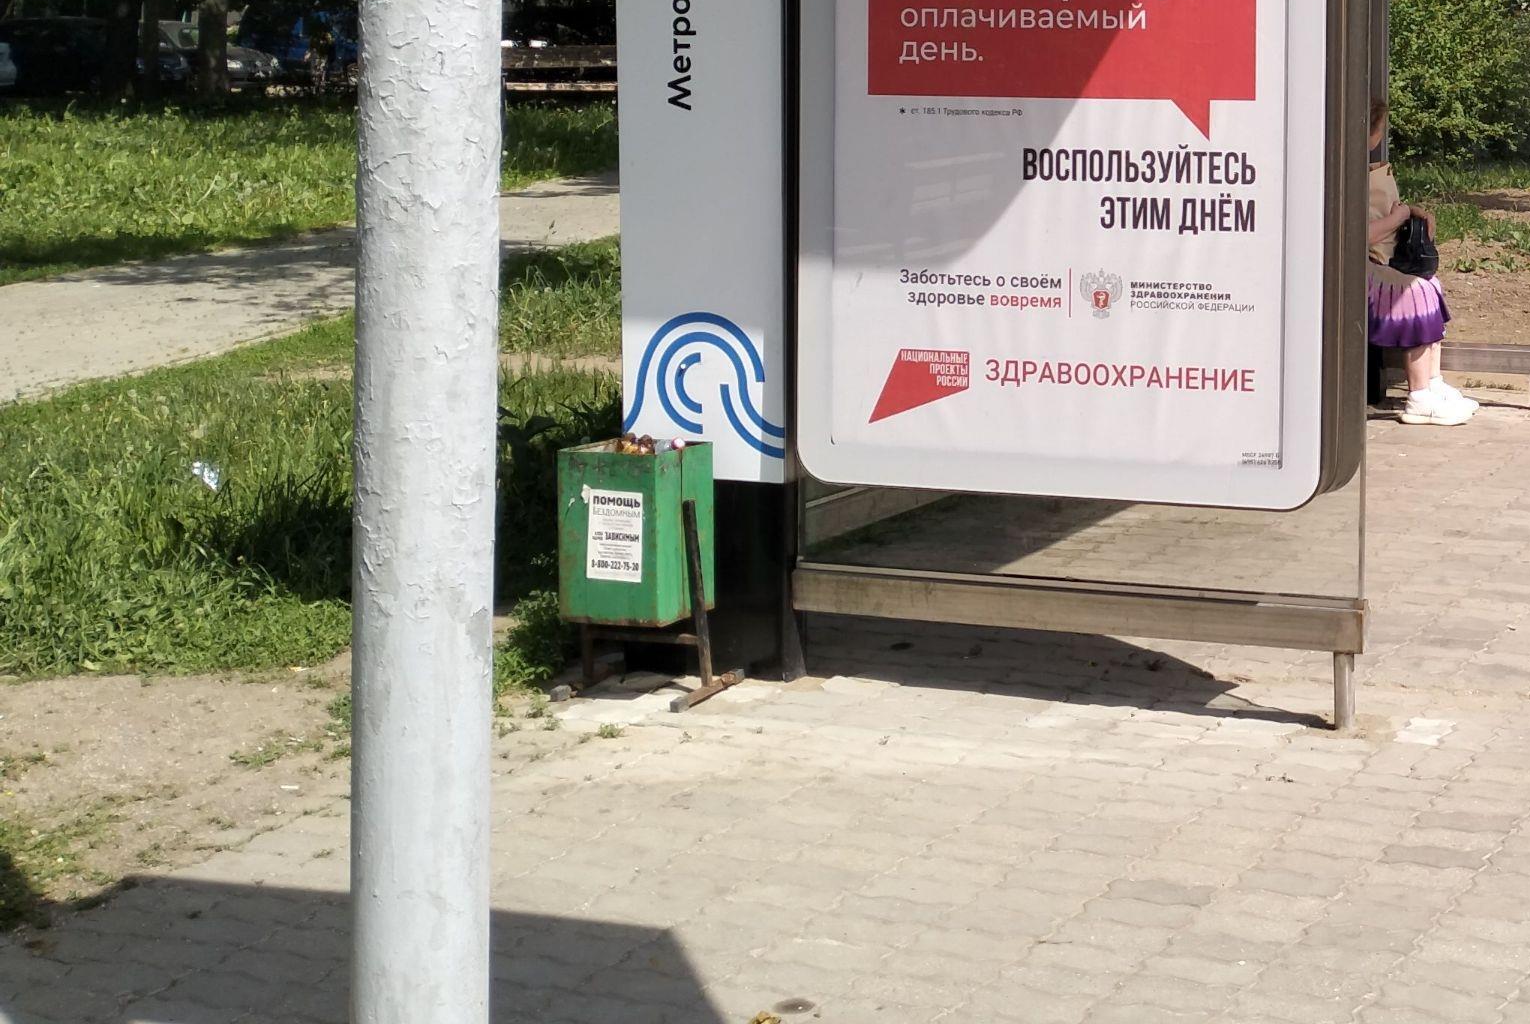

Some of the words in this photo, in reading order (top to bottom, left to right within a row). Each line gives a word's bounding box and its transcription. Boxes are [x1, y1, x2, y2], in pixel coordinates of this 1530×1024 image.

[900, 3, 1147, 29] оплачиваемый
[899, 40, 984, 64] день.
[1011, 108, 1023, 117] РФ
[1022, 145, 1257, 185] ВОСПОЛЬЗУЙТЕСЬ
[1099, 196, 1171, 232] ЭТИМ
[1178, 193, 1256, 236] ДНЁМ
[900, 268, 991, 288] Заботьтесь
[996, 277, 1006, 288] о
[1010, 273, 1063, 290] своём
[1130, 281, 1213, 292] МИНИСТЕРСТВО
[907, 289, 985, 307] здоровье
[990, 293, 1062, 309] вовремя
[1130, 290, 1232, 301] ЗДРАВООХРАНЕНИЯ
[1130, 300, 1195, 310] РОССИЙСКОЙ
[1197, 302, 1256, 313] ФЕДЕРАЦИИ
[900, 350, 969, 365] НАЦИОНАЛЬНЫЕ
[929, 363, 969, 376] ПРОЕКТЫ
[985, 359, 1256, 392] ЗДРАВООХРАНЕНИЕ
[936, 374, 969, 388] РОССИИ
[593, 496, 641, 508] ПОМОЩЬ
